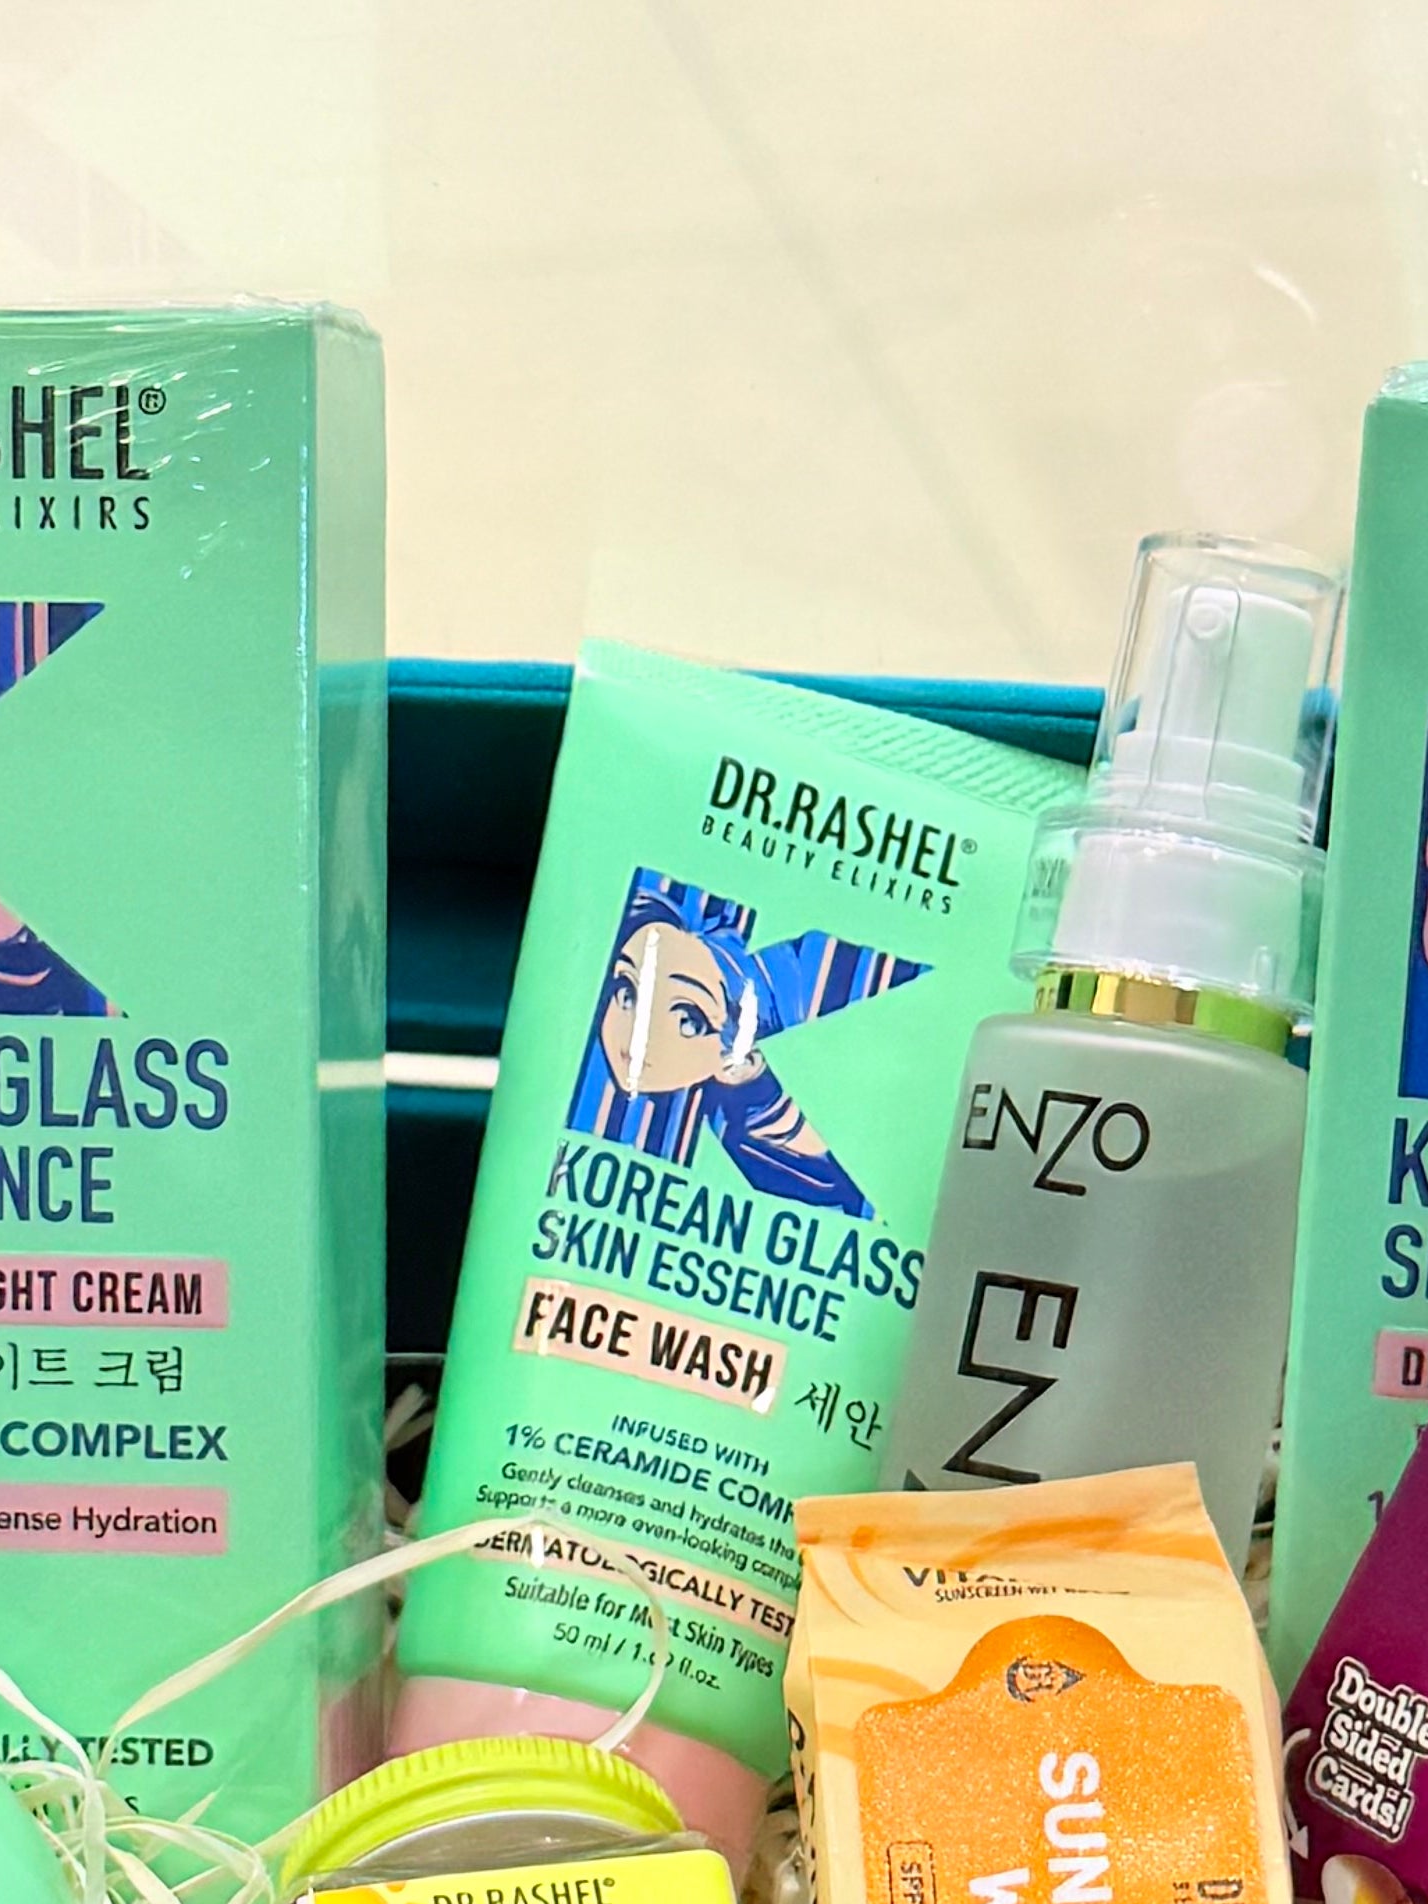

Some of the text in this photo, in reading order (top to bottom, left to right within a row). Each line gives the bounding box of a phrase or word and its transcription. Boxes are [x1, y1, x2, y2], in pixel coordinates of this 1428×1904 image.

[702, 815, 953, 916] BEAUTY ELIXIRS
[963, 1084, 1150, 1196] ENZO
[546, 1138, 926, 1310] KOREAN GLASS
[72, 1270, 203, 1316] CREAM
[532, 1207, 845, 1344] SKIN ESSENCE
[93, 1345, 185, 1396] 크림
[524, 1290, 774, 1398] FACE WASH
[0, 1421, 228, 1461] COMPLEX
[506, 1423, 546, 1450] 1%
[554, 1432, 712, 1491] CERAMIDE
[612, 1413, 769, 1476] INFUSED WITH
[72, 1507, 218, 1542] Hydration
[502, 1461, 561, 1490] Gently
[567, 1475, 645, 1506] cleanses
[650, 1496, 684, 1519] and
[690, 1506, 765, 1548] hydrates
[768, 1537, 794, 1561] the
[561, 1501, 571, 1514] a
[577, 1505, 626, 1528] more
[505, 1576, 589, 1611] Suitable
[595, 1593, 627, 1619] for
[685, 1621, 725, 1654] Skin
[730, 1638, 774, 1678] Types
[554, 1622, 579, 1644] 50
[584, 1632, 609, 1655] ml
[614, 1638, 627, 1655] /
[1329, 1712, 1409, 1785] Sided
[1313, 1756, 1407, 1835] Cards!
